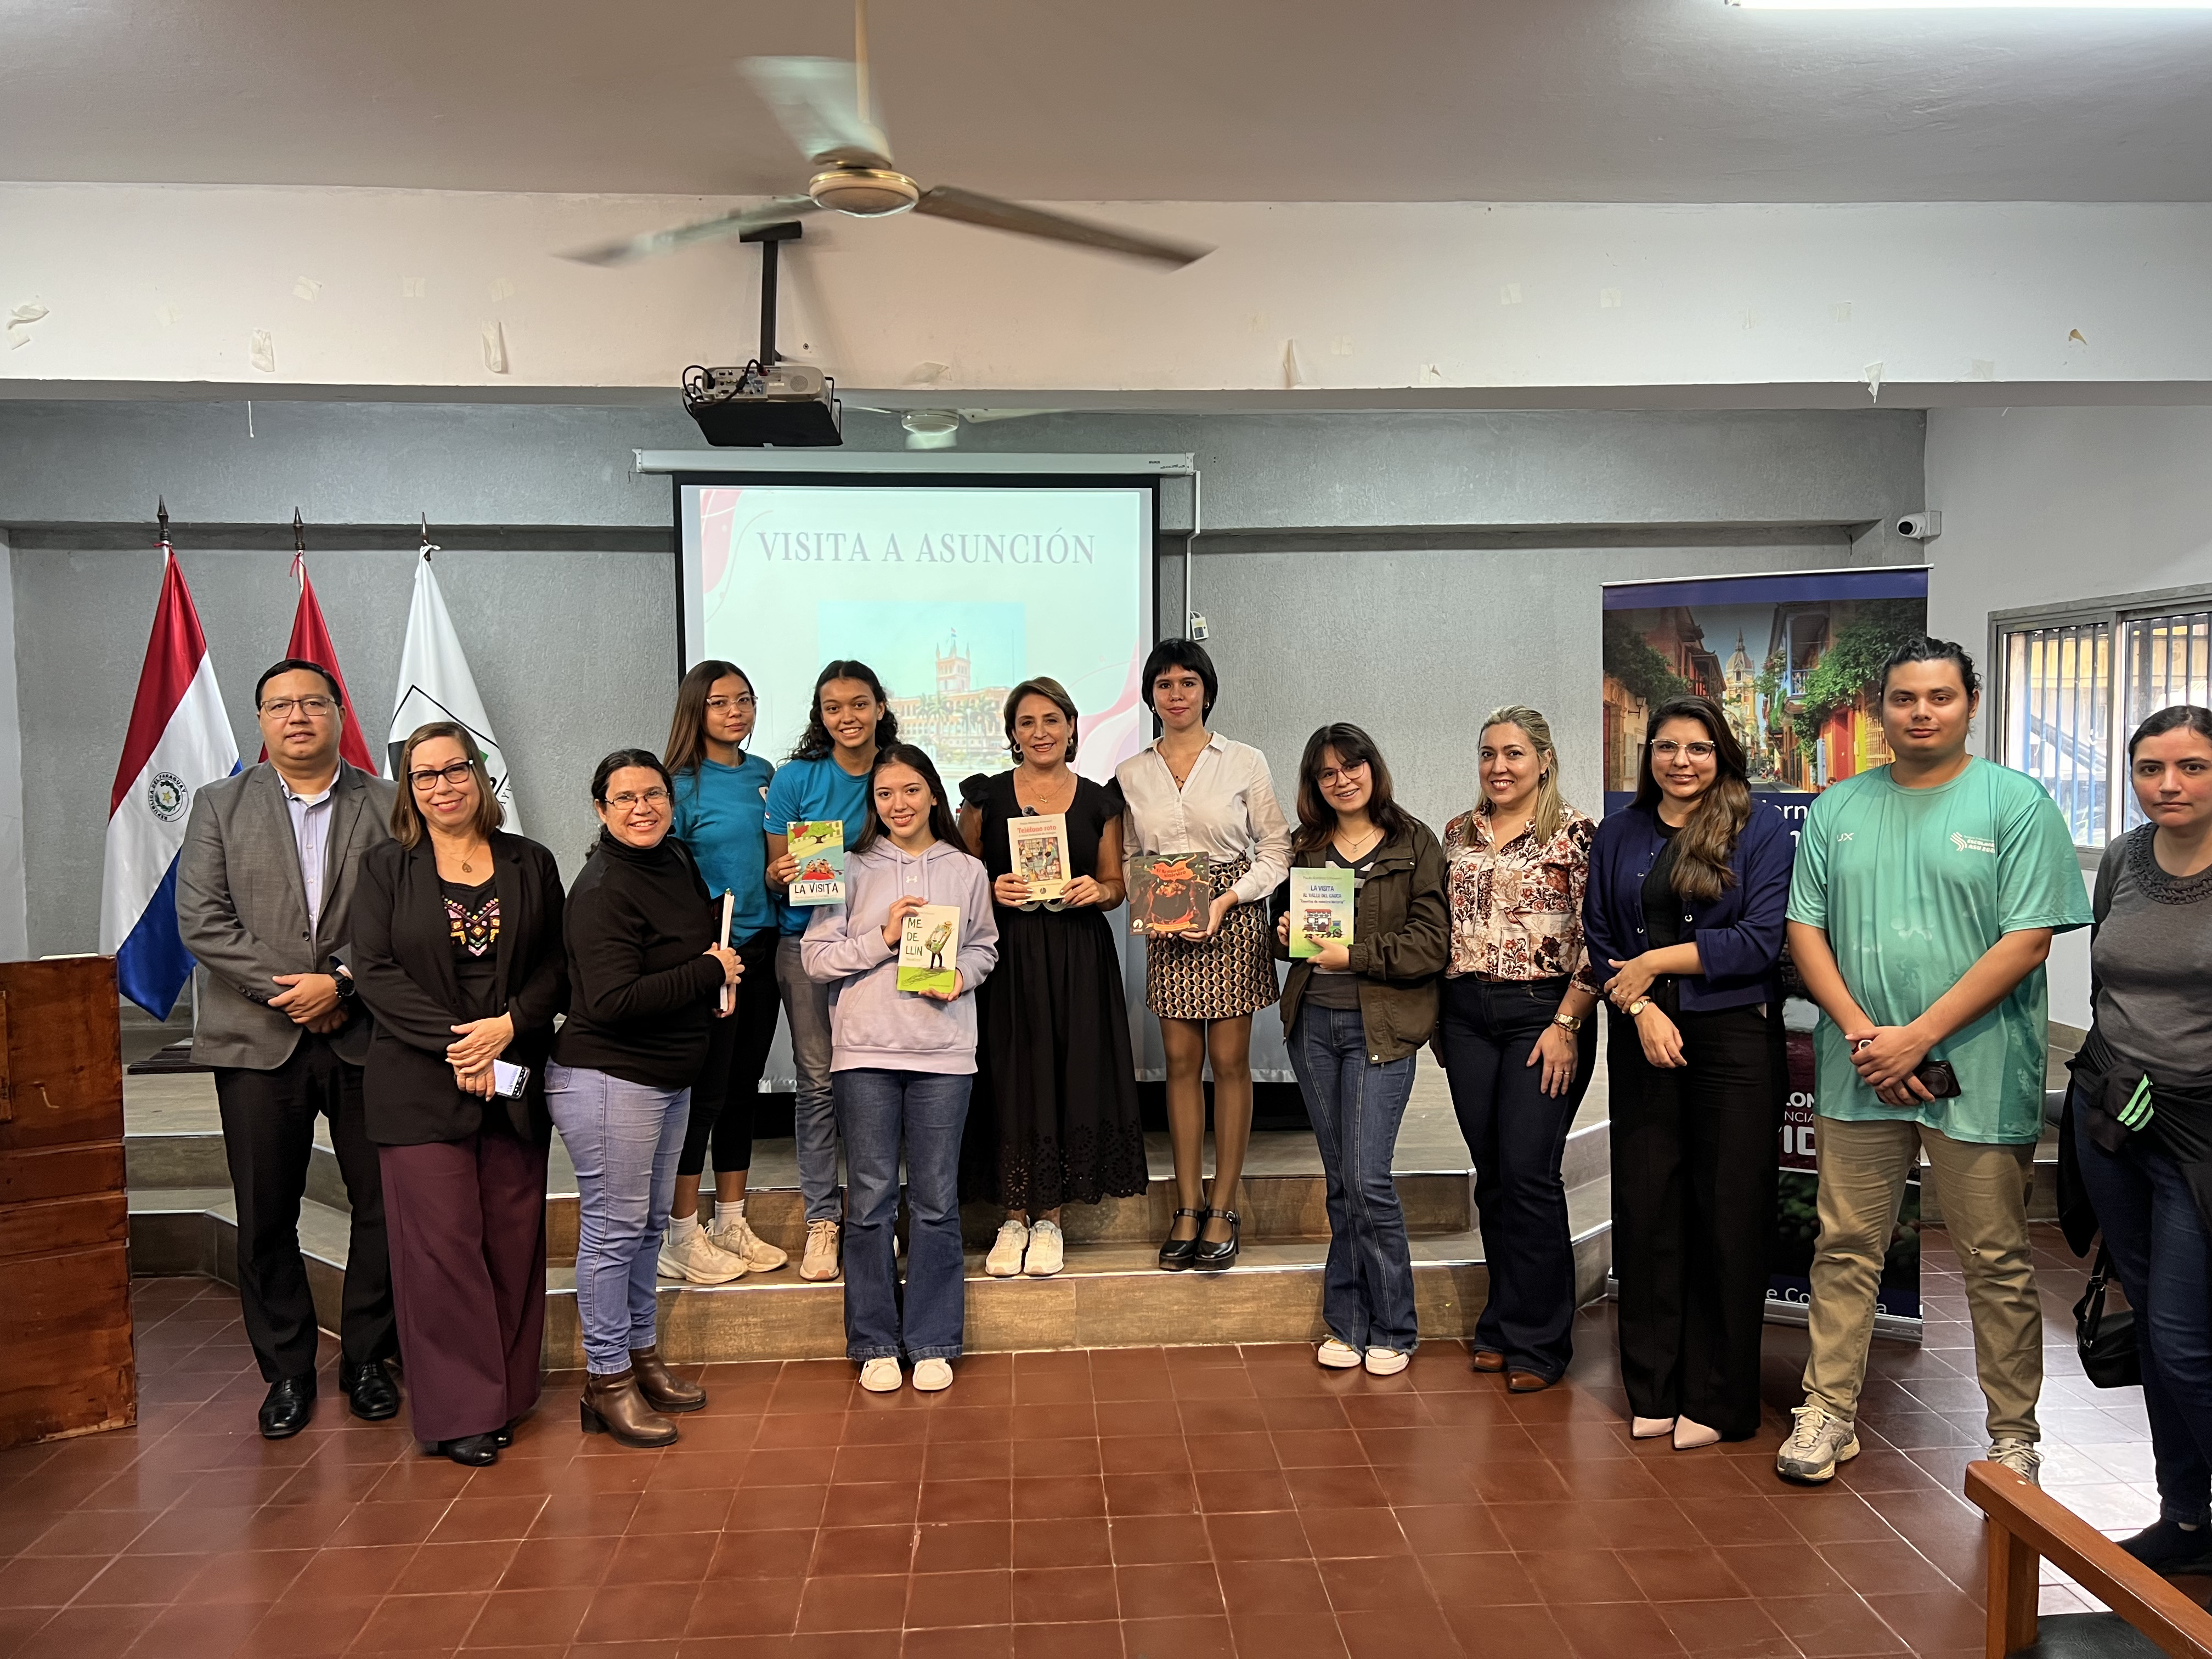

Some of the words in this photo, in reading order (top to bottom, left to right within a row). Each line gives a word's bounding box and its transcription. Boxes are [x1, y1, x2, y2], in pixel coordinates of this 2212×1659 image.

[756, 532, 871, 562] VISITA
[881, 533, 905, 562] A
[915, 527, 1096, 565] ASUNCIÓN
[159, 774, 187, 793] PARAGUAY
[794, 884, 806, 895] LA
[809, 882, 839, 895] VISITA
[907, 917, 923, 929] ME
[906, 932, 919, 942] DE
